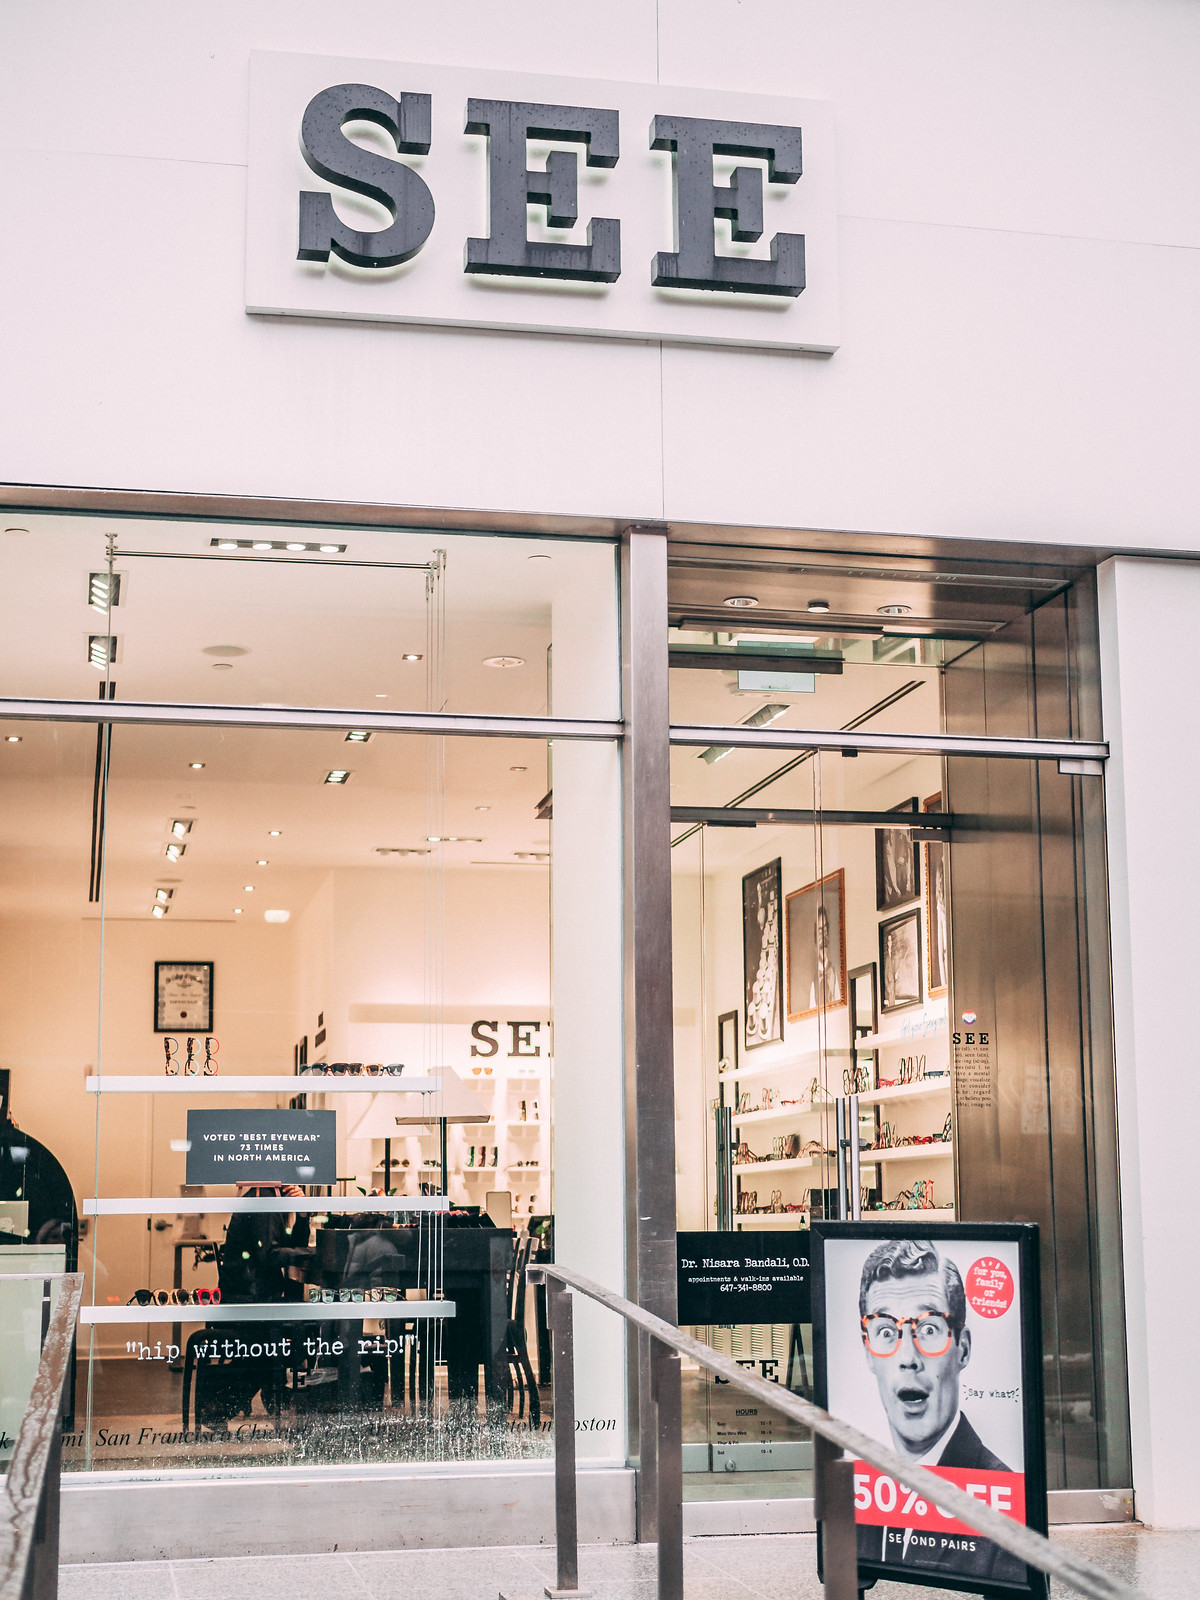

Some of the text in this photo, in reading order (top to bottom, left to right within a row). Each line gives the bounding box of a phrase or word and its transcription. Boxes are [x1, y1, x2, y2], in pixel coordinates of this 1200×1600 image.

[297, 83, 806, 297] SEE
[470, 1020, 550, 1057] SE
[952, 1032, 989, 1045] SEE
[203, 1133, 321, 1142] VOTED "BEST EYEWEAR"
[240, 1143, 284, 1151] 73 TIMES
[213, 1154, 310, 1162] IN NORTH AMERICA
[681, 1257, 810, 1269] Dr. Nisara Bandali, O.D.
[973, 1266, 988, 1276] for
[720, 1283, 773, 1292] 647-341-8800
[975, 1277, 1004, 1290] family
[971, 1296, 1008, 1309] friends!
[126, 1340, 180, 1363] "hip
[193, 1337, 291, 1359] without
[303, 1337, 344, 1357] the
[968, 1388, 1016, 1399] Say what?
[735, 1408, 758, 1416] HOURS
[95, 1428, 131, 1447] San
[137, 1425, 231, 1447] Francisco
[573, 1415, 617, 1432] oston
[854, 1473, 1012, 1519] 50% FF
[941, 1540, 977, 1552] PAIRS
